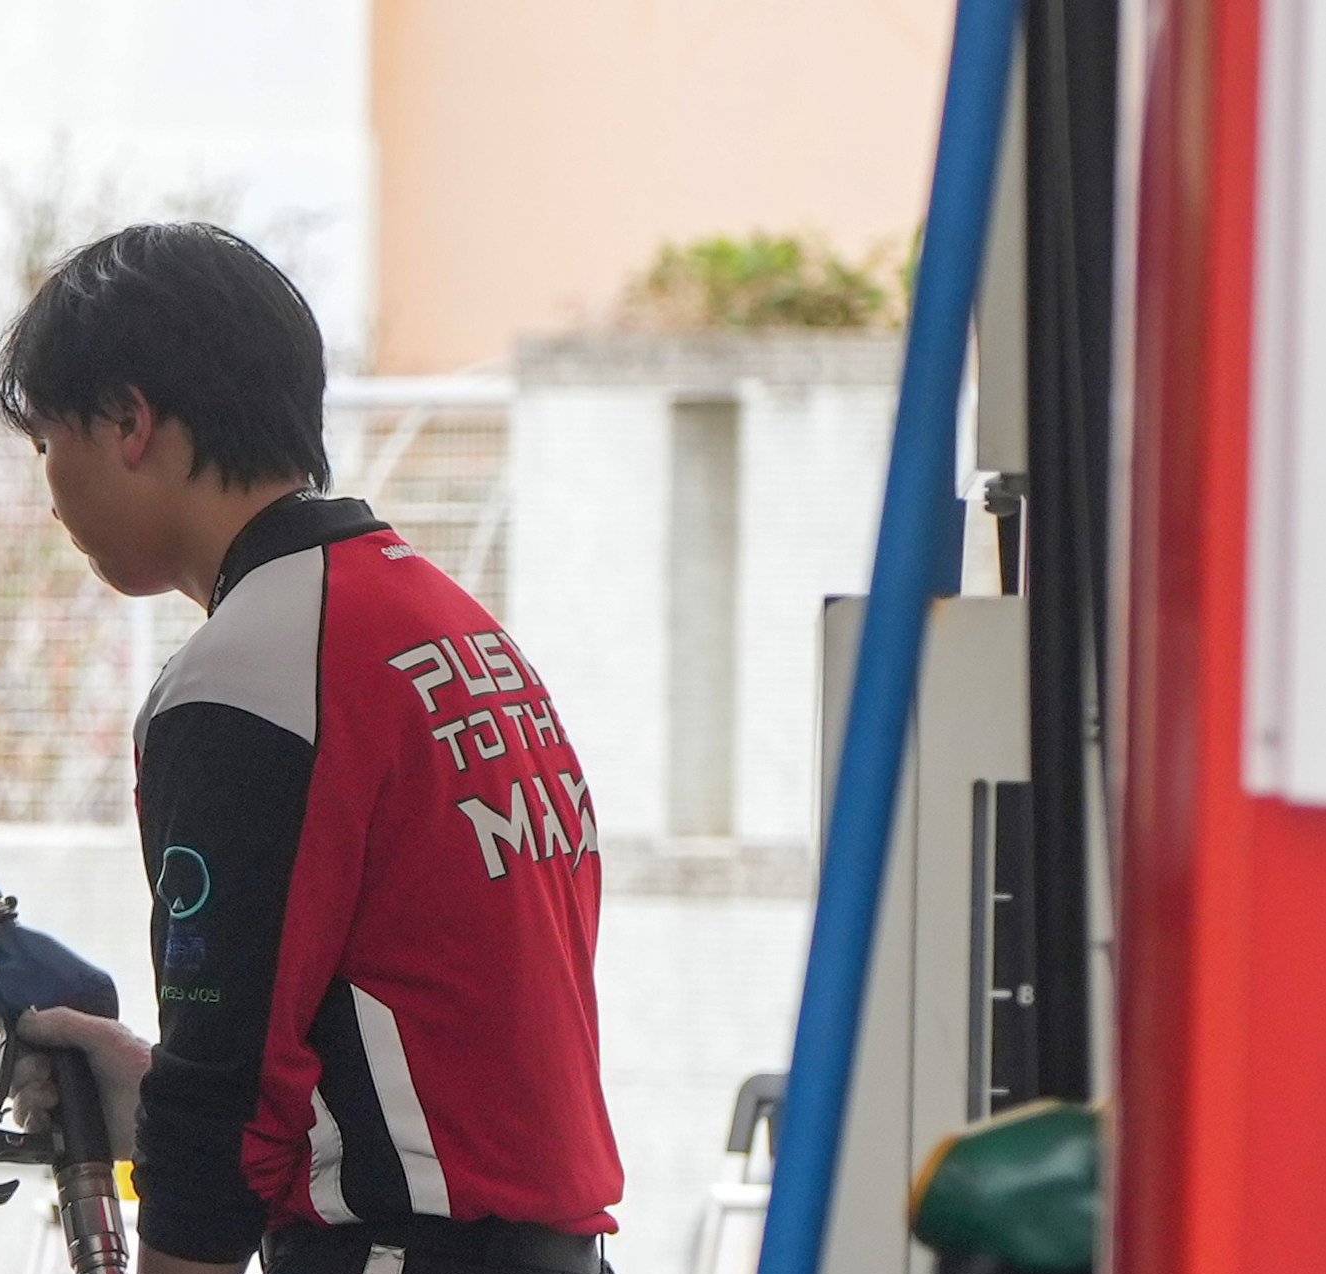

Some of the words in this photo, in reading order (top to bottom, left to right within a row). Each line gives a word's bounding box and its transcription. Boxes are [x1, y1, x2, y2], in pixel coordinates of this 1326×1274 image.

[431, 708, 506, 771] TO
[456, 770, 598, 880] MAX
[188, 987, 221, 1003] JOY
